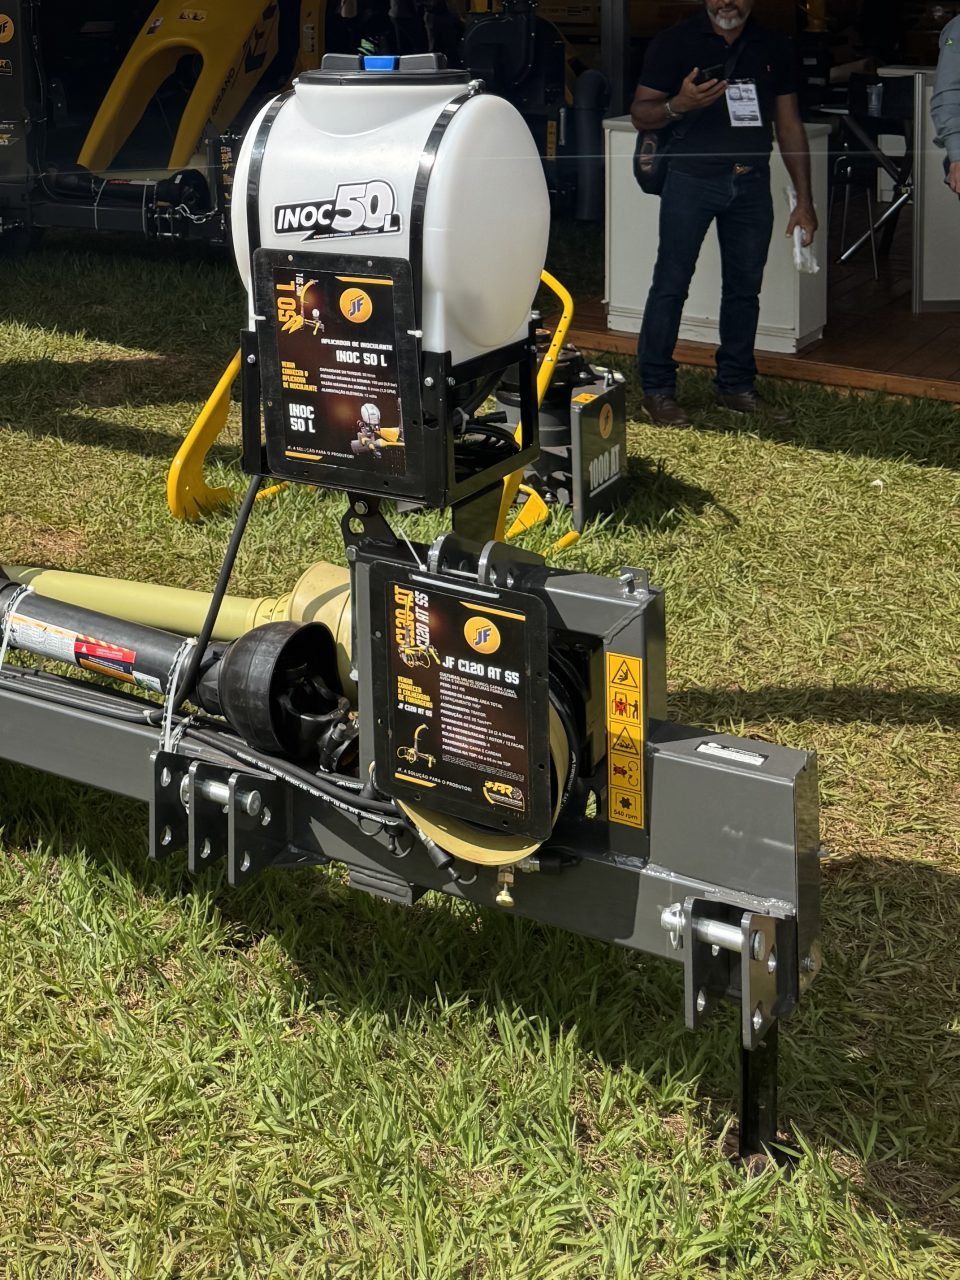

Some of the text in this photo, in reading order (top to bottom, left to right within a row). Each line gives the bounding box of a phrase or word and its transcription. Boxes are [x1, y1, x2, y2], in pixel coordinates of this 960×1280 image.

[277, 203, 333, 230] INOC
[331, 180, 394, 232] 50
[348, 295, 365, 317] JF
[336, 350, 388, 367] INOC 50 L
[288, 403, 315, 418] INOC
[289, 418, 316, 433] 50 L
[473, 625, 491, 646] JF
[442, 656, 456, 669] JF
[458, 659, 484, 676] C120
[487, 666, 501, 680] AT
